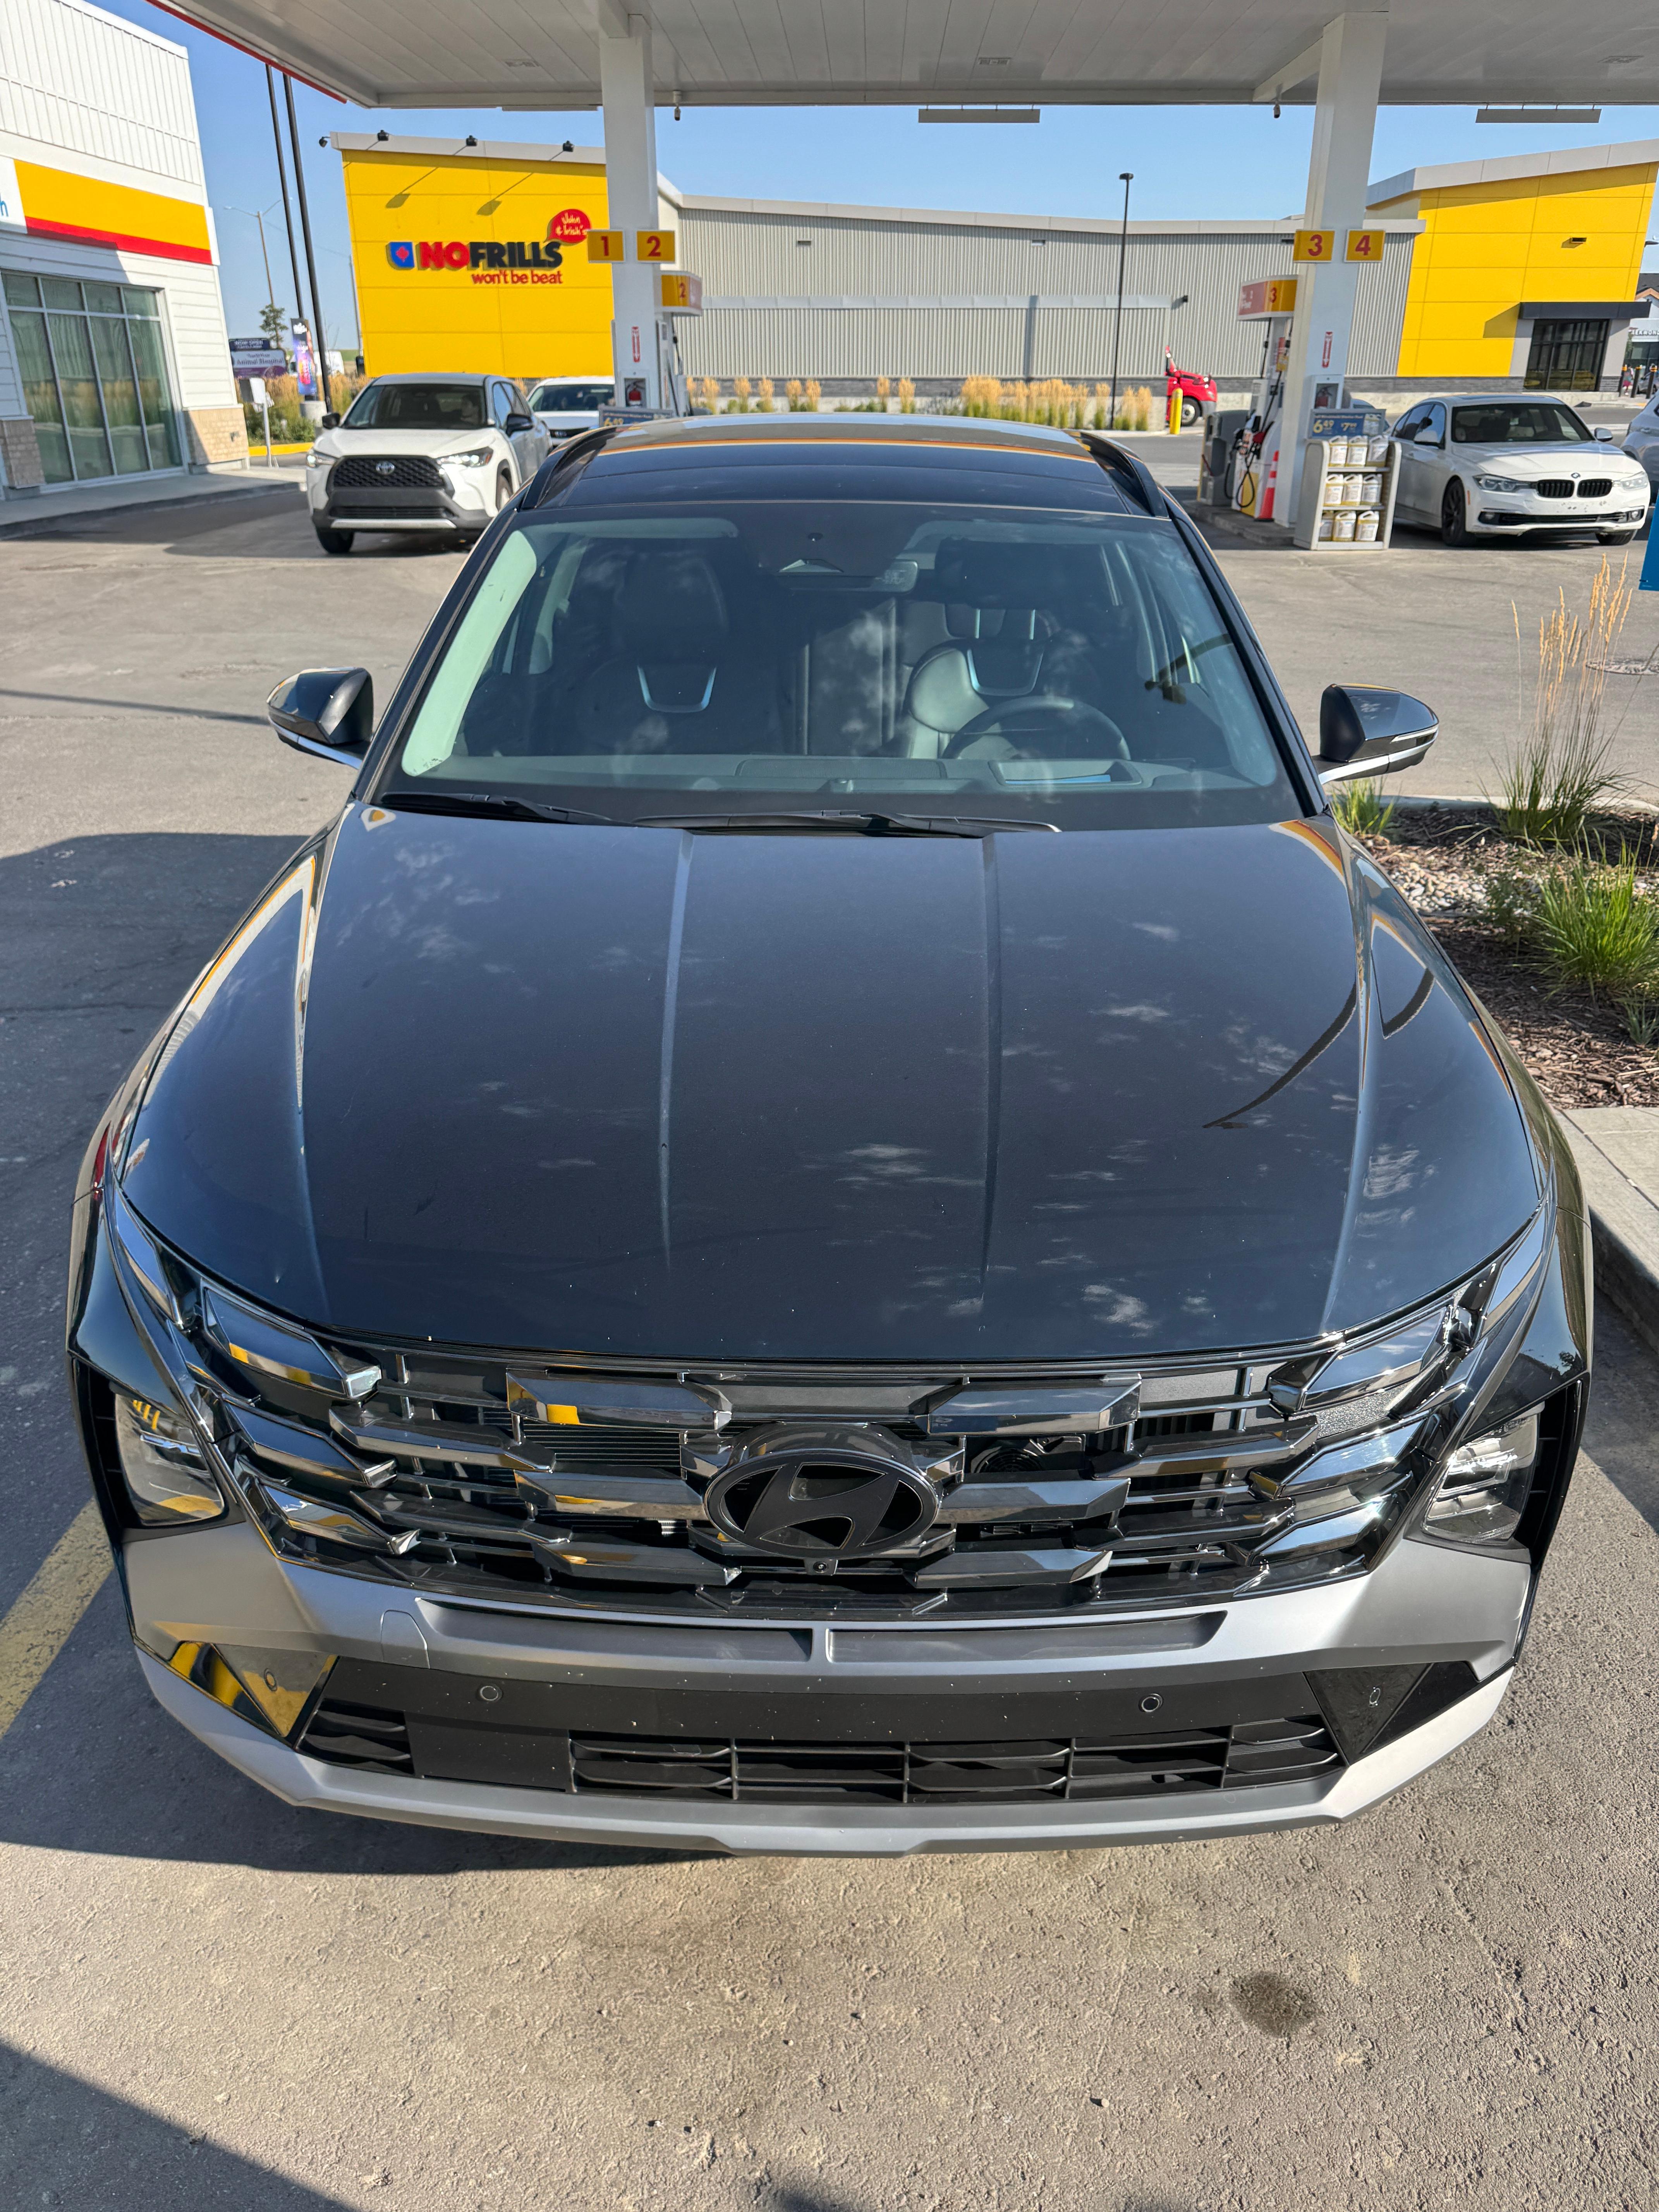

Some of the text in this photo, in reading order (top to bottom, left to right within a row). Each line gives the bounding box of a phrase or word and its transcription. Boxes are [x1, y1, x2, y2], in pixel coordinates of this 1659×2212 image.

[601, 236, 609, 256] 1
[647, 235, 661, 257] 2
[1308, 234, 1322, 256] 3
[1355, 235, 1371, 256] 4
[471, 270, 563, 284] won't be beat
[679, 283, 686, 298] 2
[1269, 287, 1277, 303] 3
